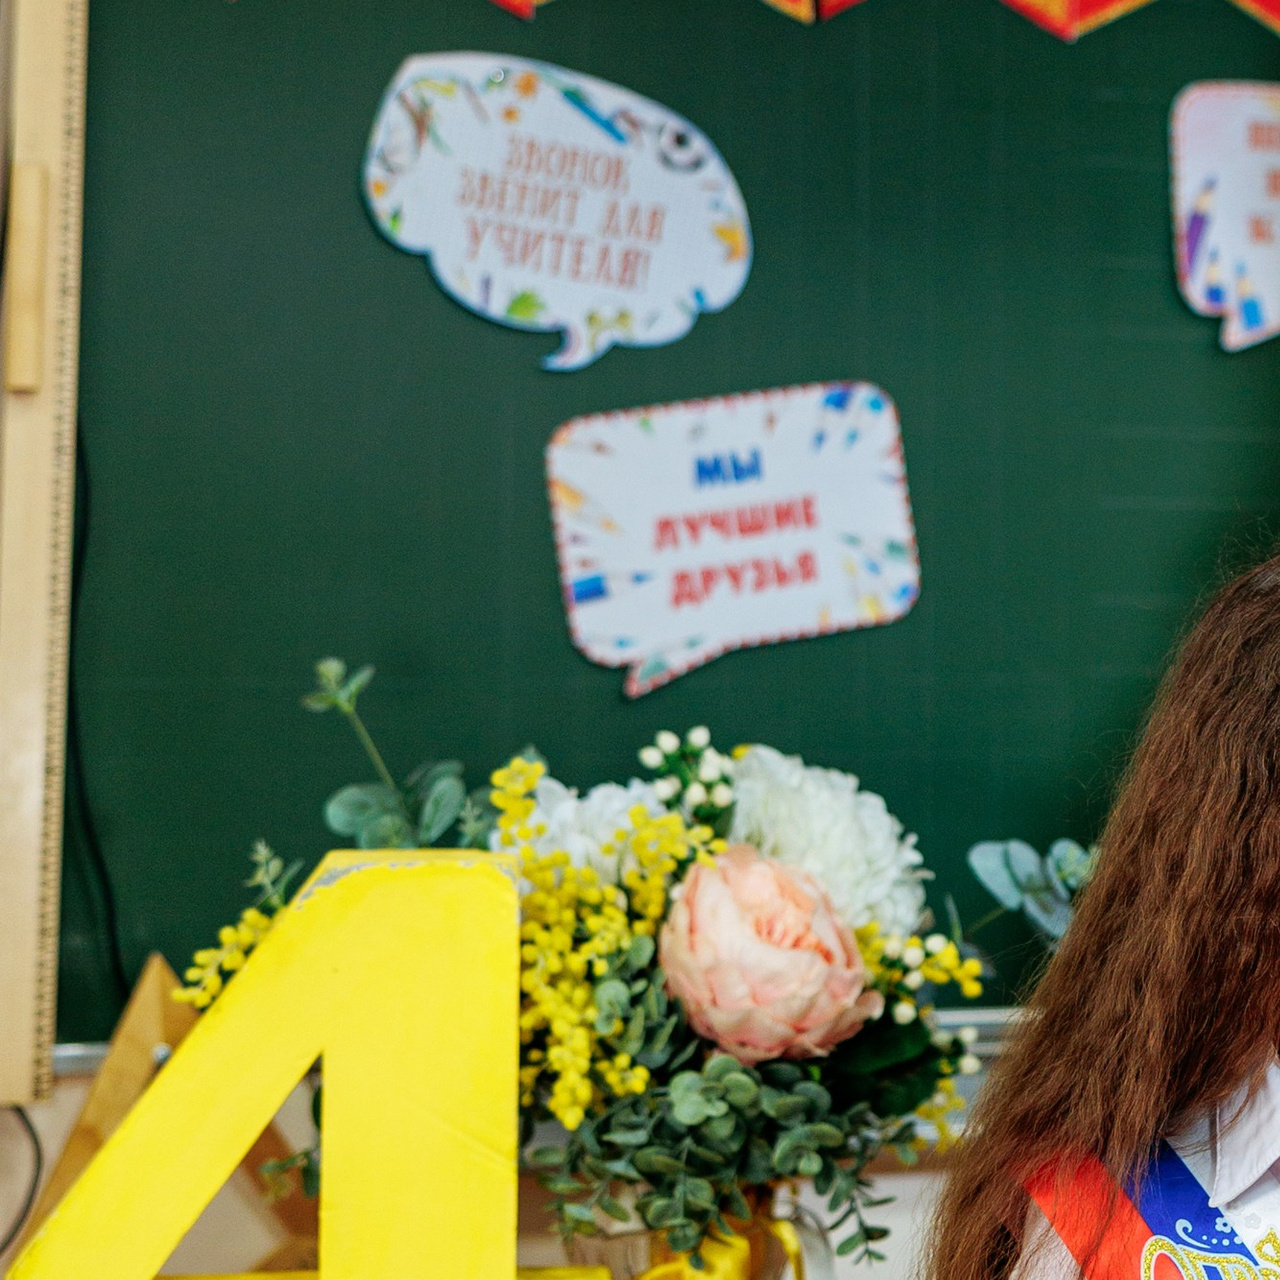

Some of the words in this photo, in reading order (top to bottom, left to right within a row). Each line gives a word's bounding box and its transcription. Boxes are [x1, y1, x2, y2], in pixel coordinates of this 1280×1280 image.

[506, 134, 630, 193] ЗВОНОК
[458, 168, 580, 225] ЗВЕНИТ
[602, 201, 666, 242] ДЛЯ
[467, 218, 652, 289] УЧИТЕЛЯ!
[694, 448, 764, 487] МЫ
[654, 496, 819, 550] ЛУЧШИЕ
[669, 552, 818, 609] ДРУЗЬЯ
